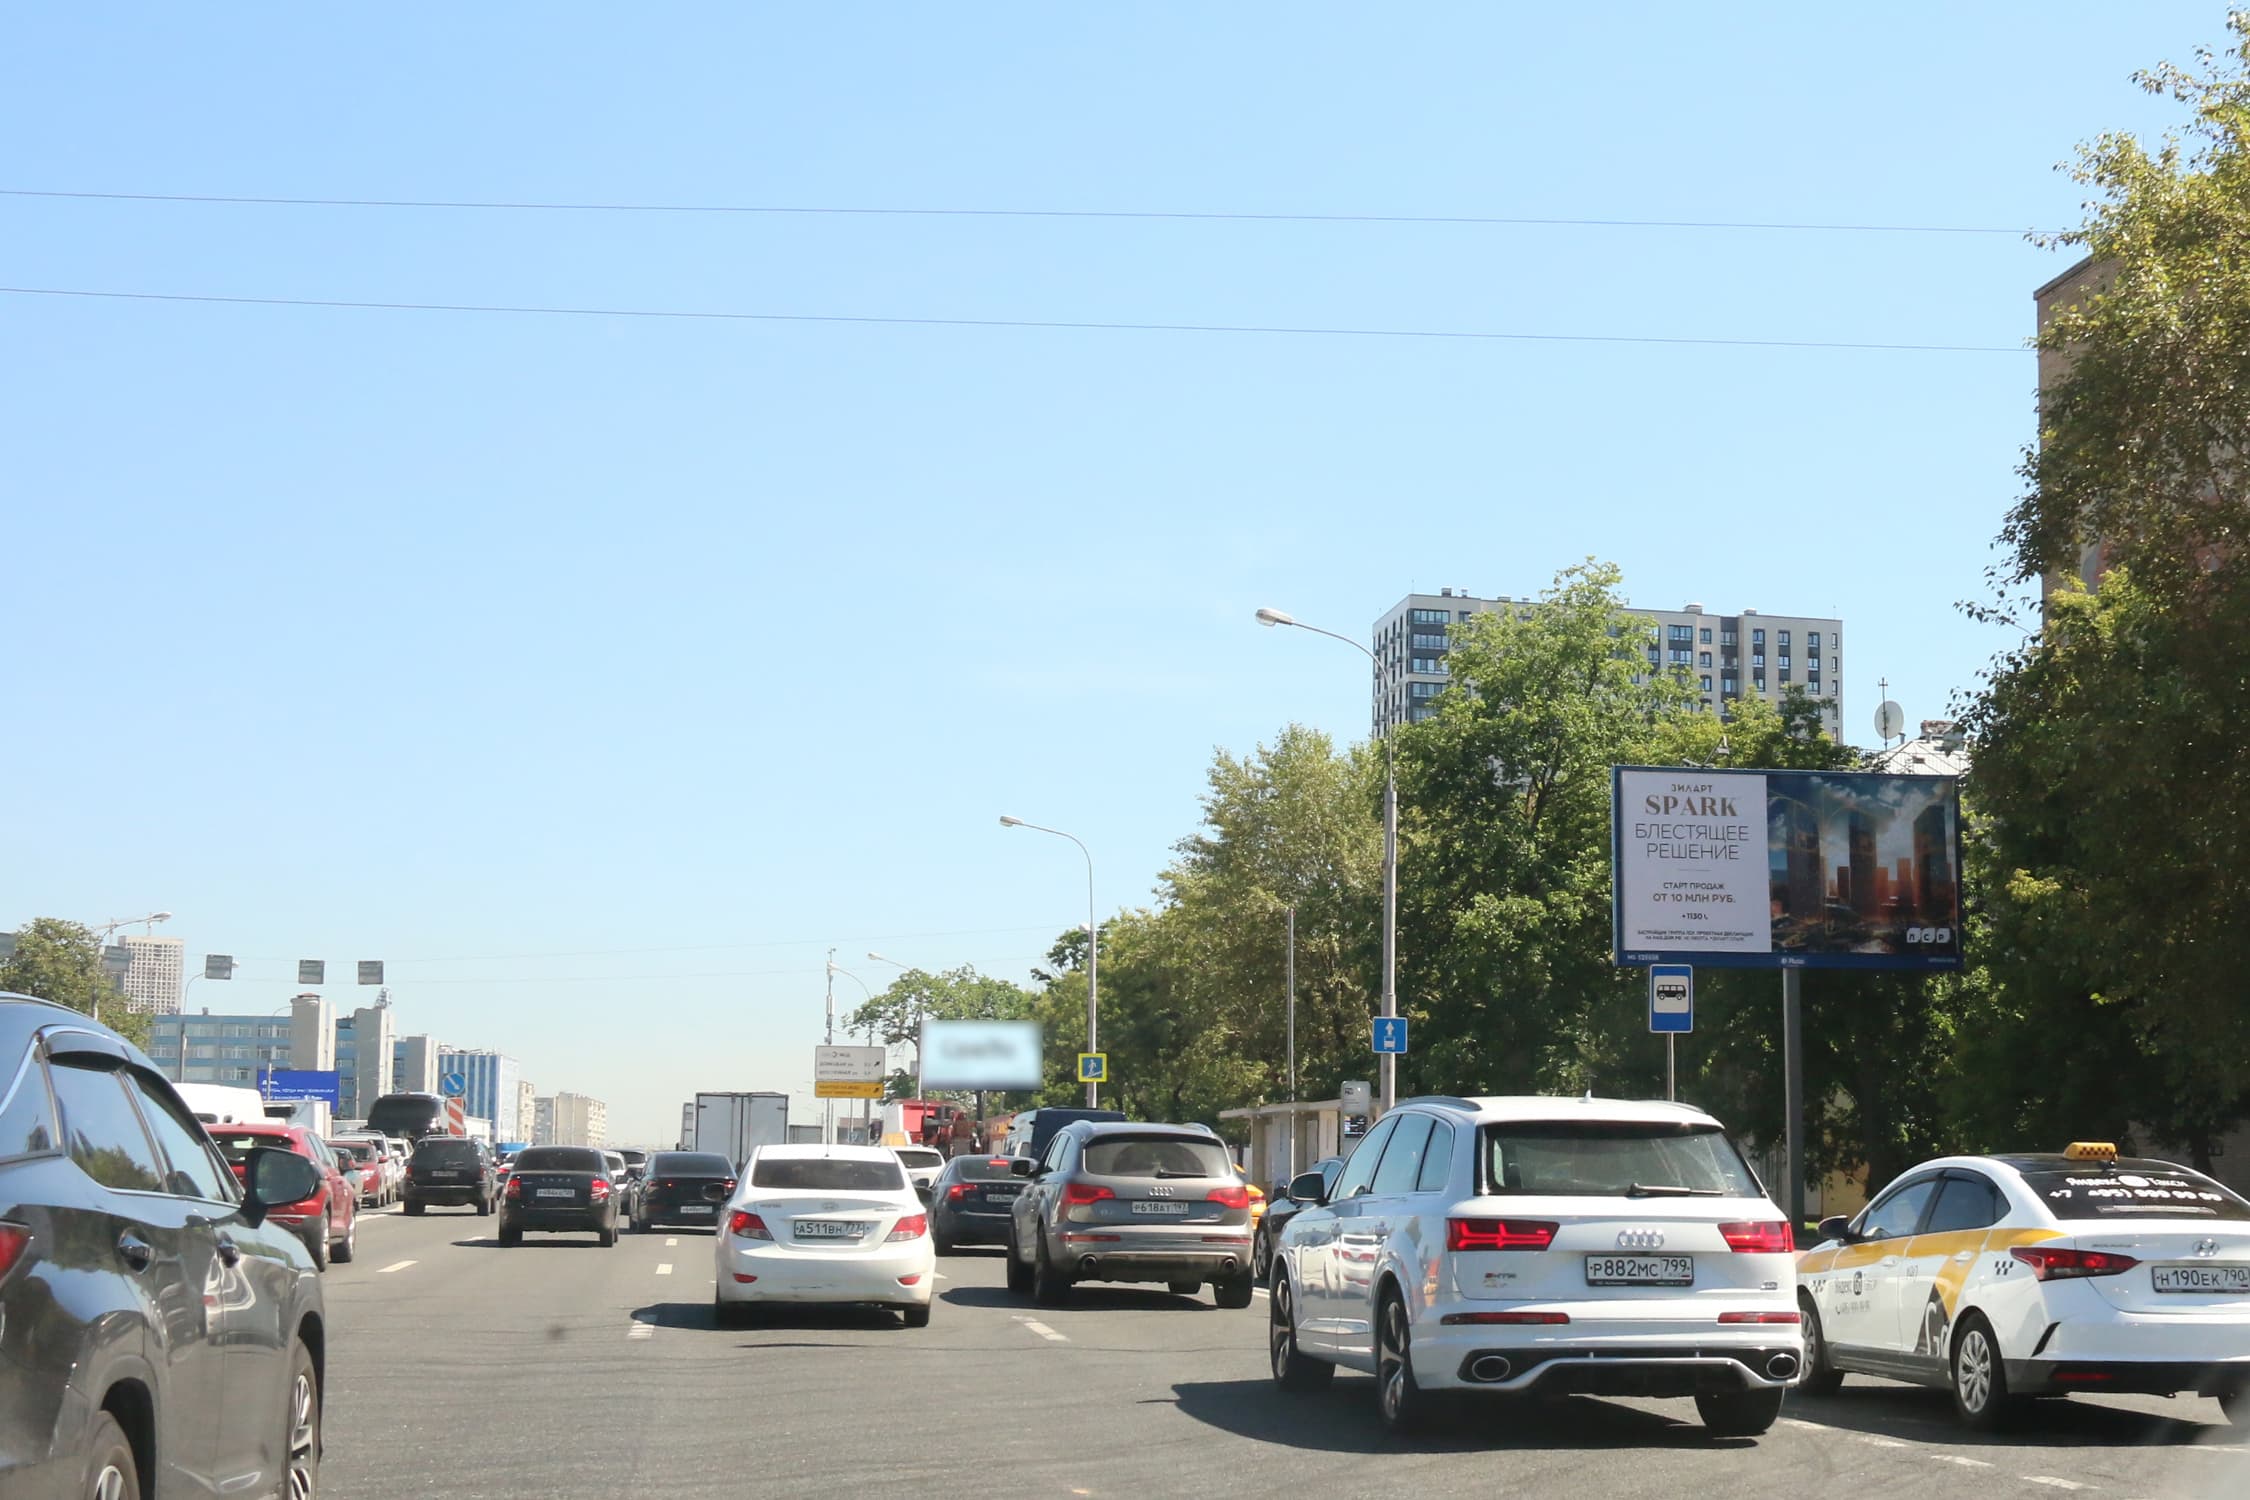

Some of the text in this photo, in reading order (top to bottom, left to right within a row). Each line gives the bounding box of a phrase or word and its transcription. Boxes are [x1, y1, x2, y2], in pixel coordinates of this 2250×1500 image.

[1671, 784, 1713, 792] ЗИЛАРТ
[1645, 795, 1737, 816] SPARK
[1635, 823, 1749, 841] БЛЕСТЯЩЕЕ
[1647, 843, 1740, 860] РЕШЕНИЕ
[1663, 882, 1725, 890] СТАРТ ПРОДАЖ
[1652, 893, 1736, 904] ОТ 10 МЛН РУБ.
[799, 1222, 842, 1235] А511ВН
[1593, 1258, 1688, 1277] Р882МС 799
[2159, 1268, 2246, 1287] Н190ЕК 790
